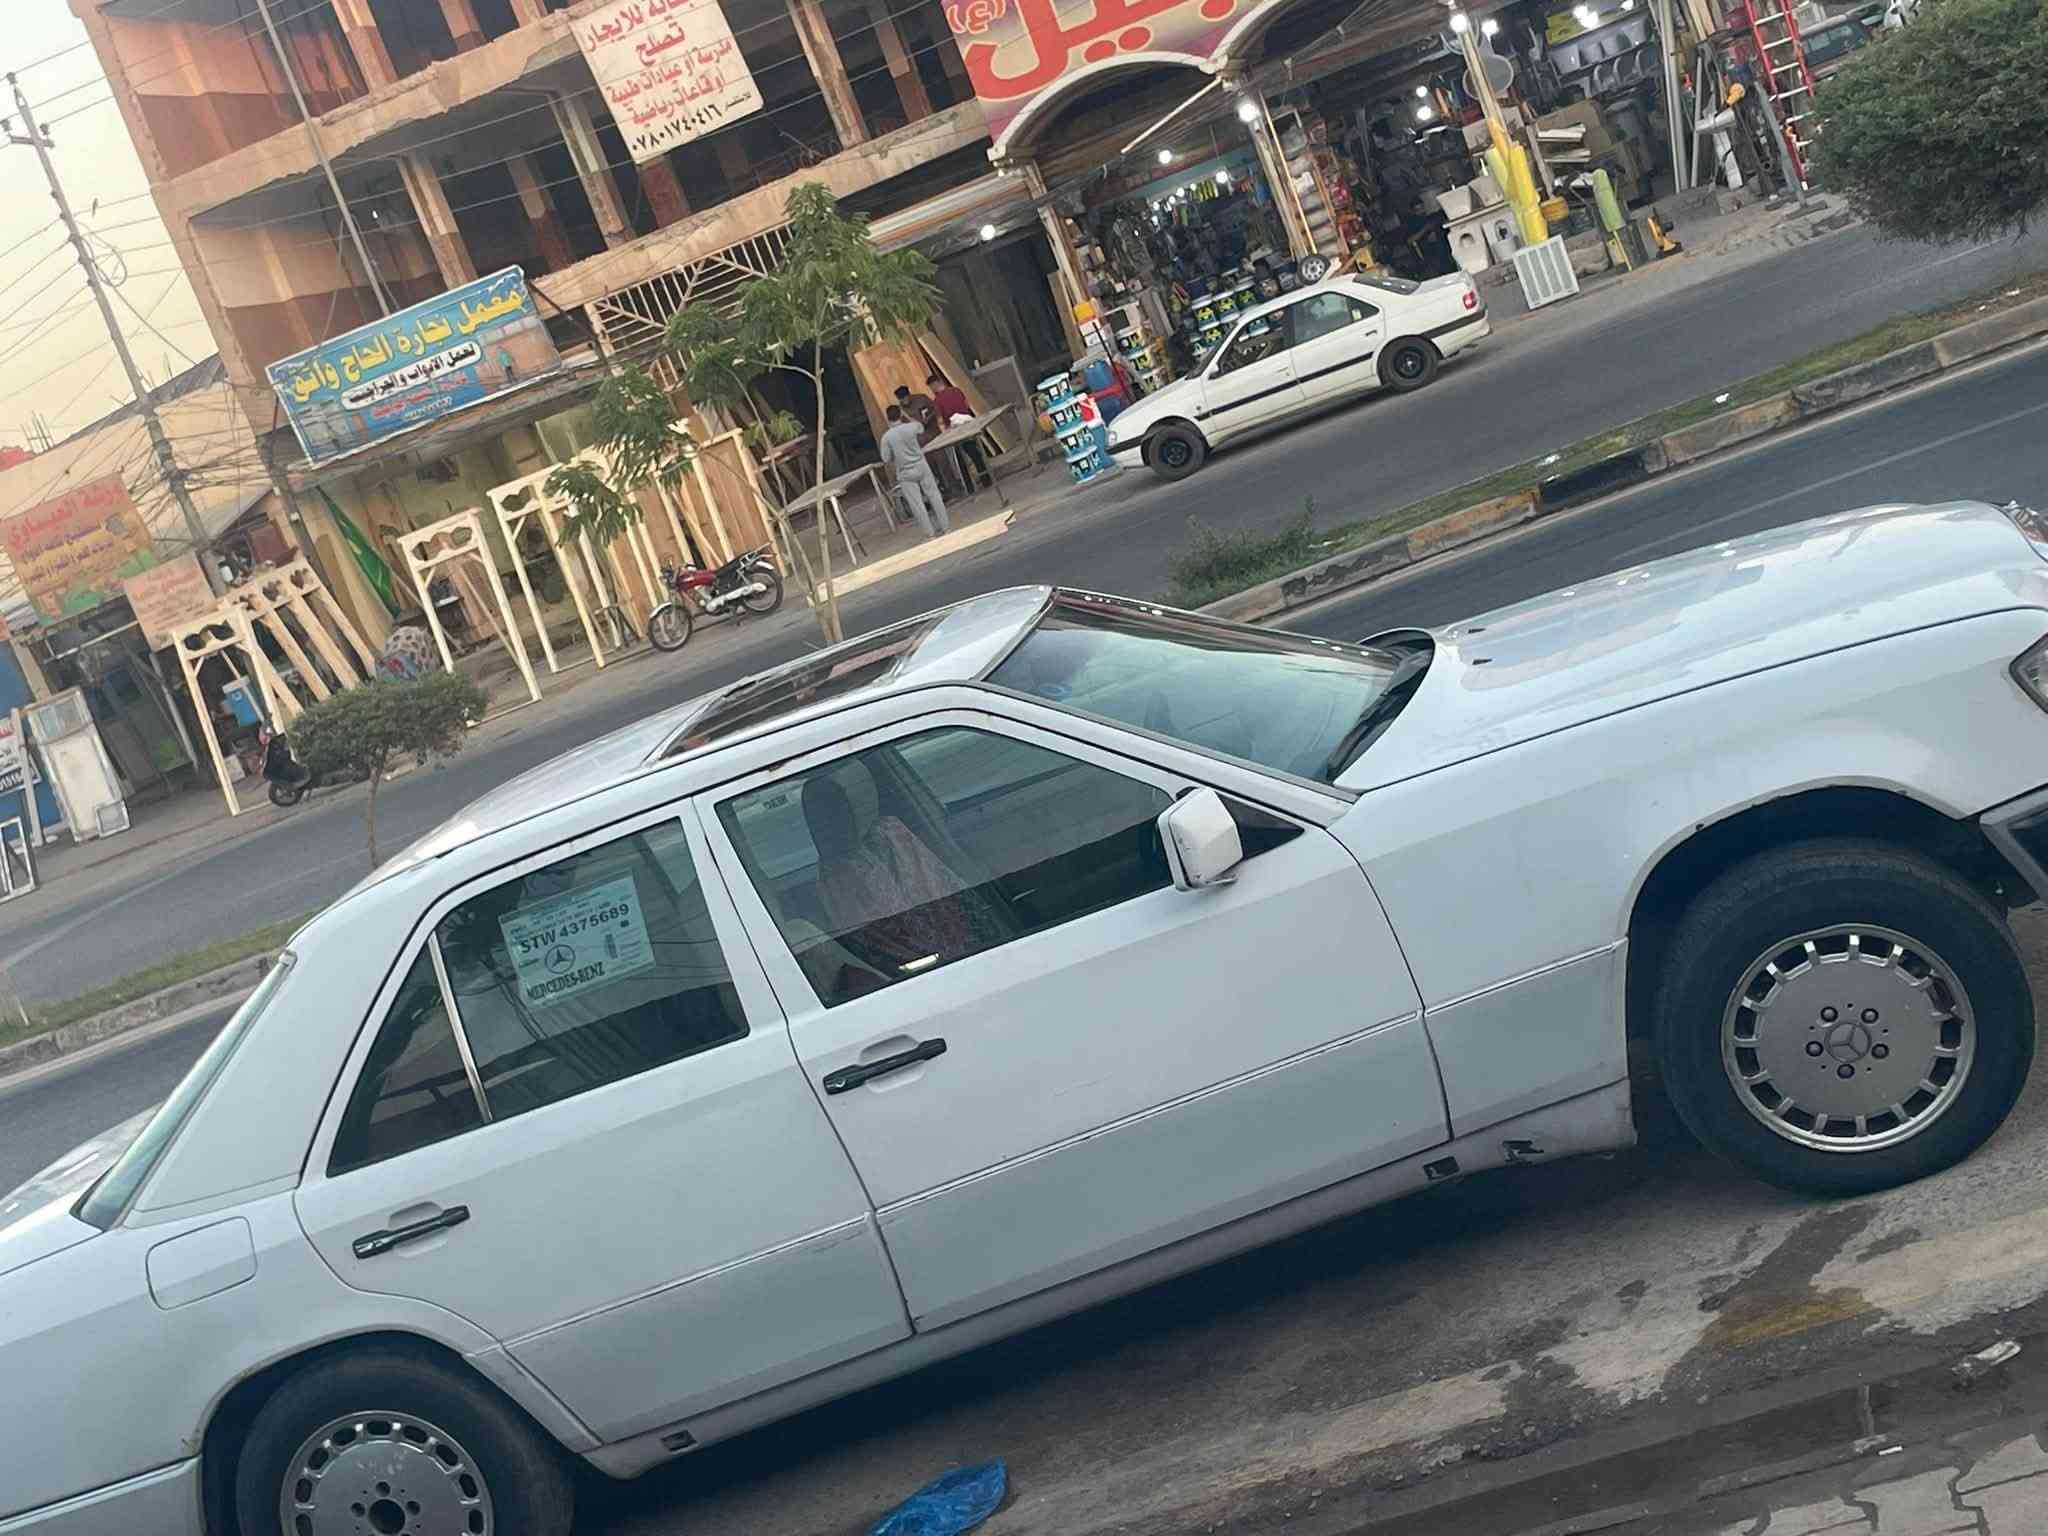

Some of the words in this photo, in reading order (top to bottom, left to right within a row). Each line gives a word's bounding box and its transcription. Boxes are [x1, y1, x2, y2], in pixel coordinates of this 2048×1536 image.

[635, 21, 685, 66] تصلح
[457, 287, 525, 335] معمل
[342, 332, 394, 383] الحاج
[397, 315, 452, 355] نجارة
